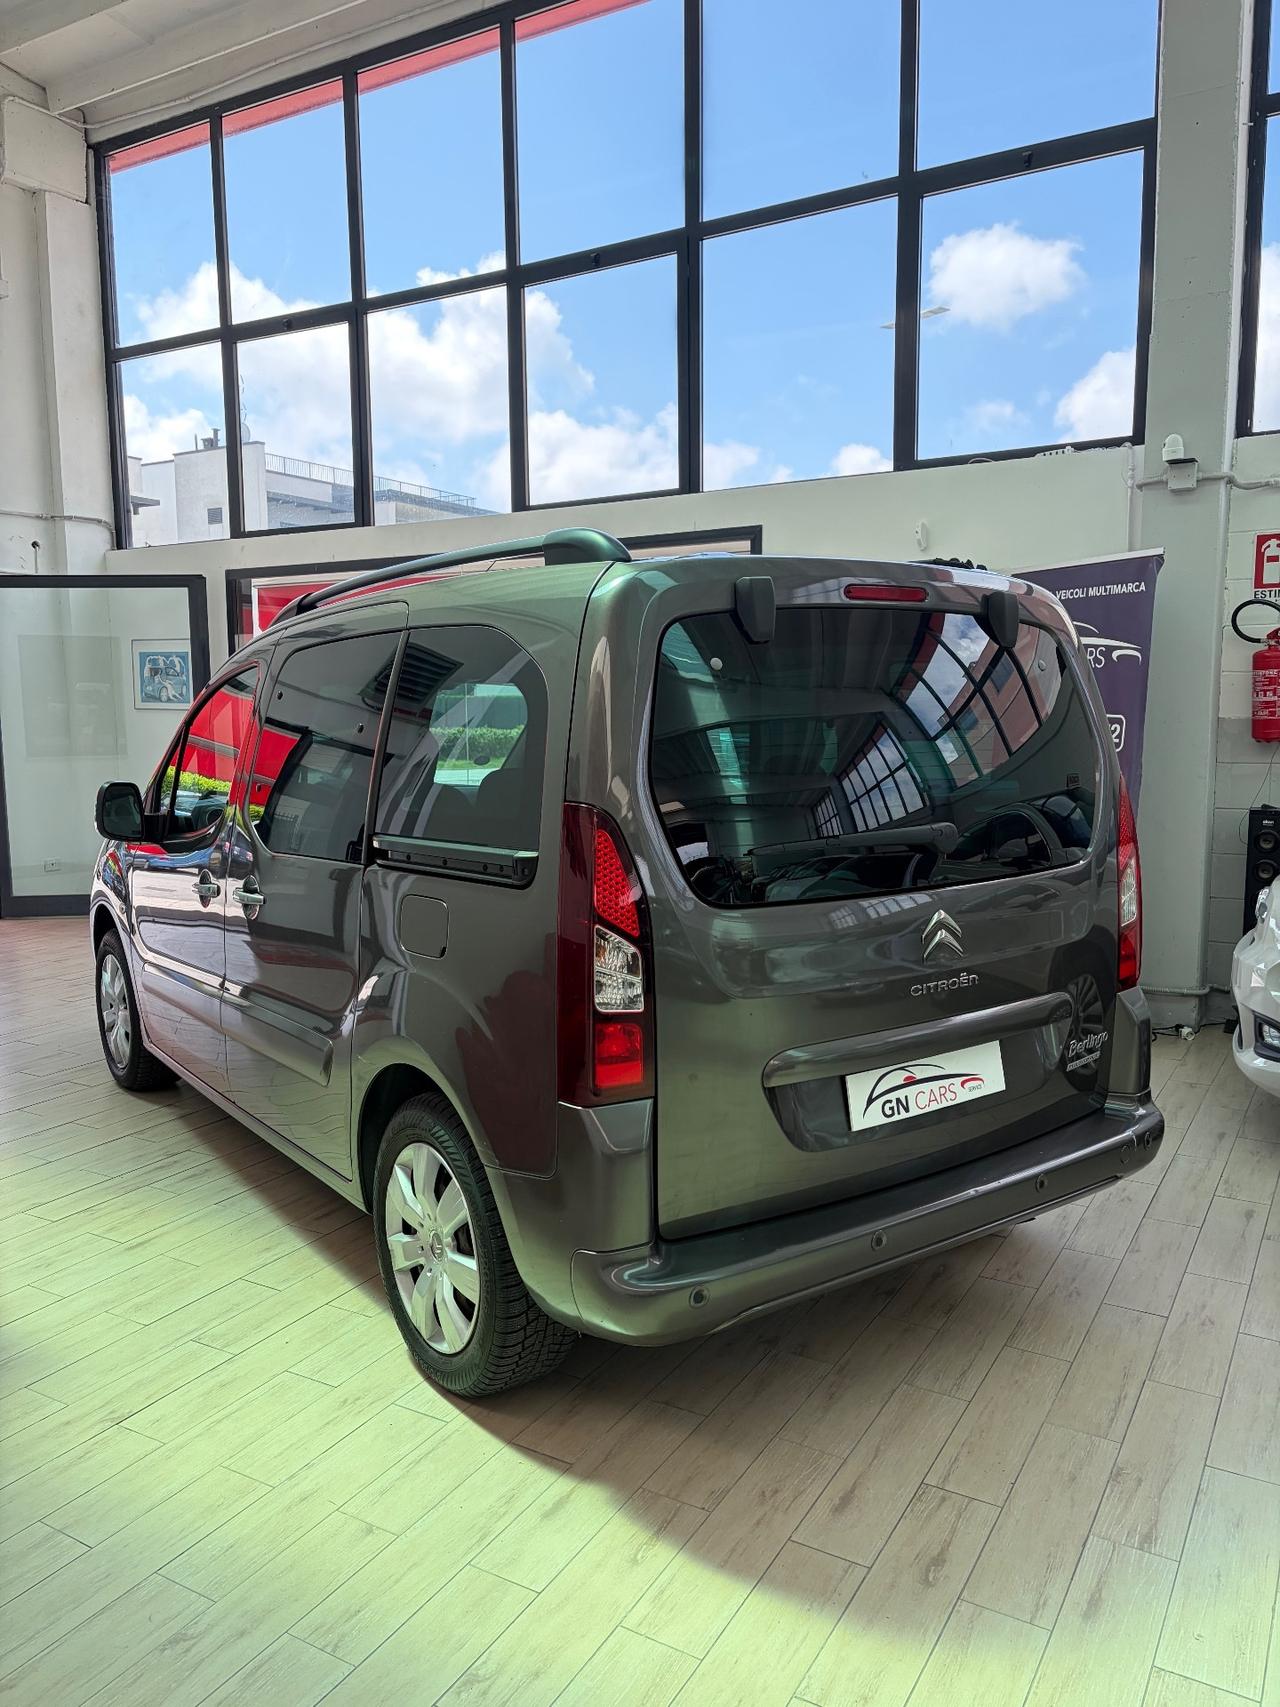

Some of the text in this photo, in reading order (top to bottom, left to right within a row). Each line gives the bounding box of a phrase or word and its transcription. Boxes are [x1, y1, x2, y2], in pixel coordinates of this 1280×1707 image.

[1056, 581, 1146, 600] VEICOLI MULTIMARCA
[1087, 646, 1106, 669] RS
[1109, 723, 1121, 743] 2
[1069, 1031, 1109, 1058] Berlingo
[881, 1095, 910, 1119] GN
[915, 1082, 958, 1110] CARS
